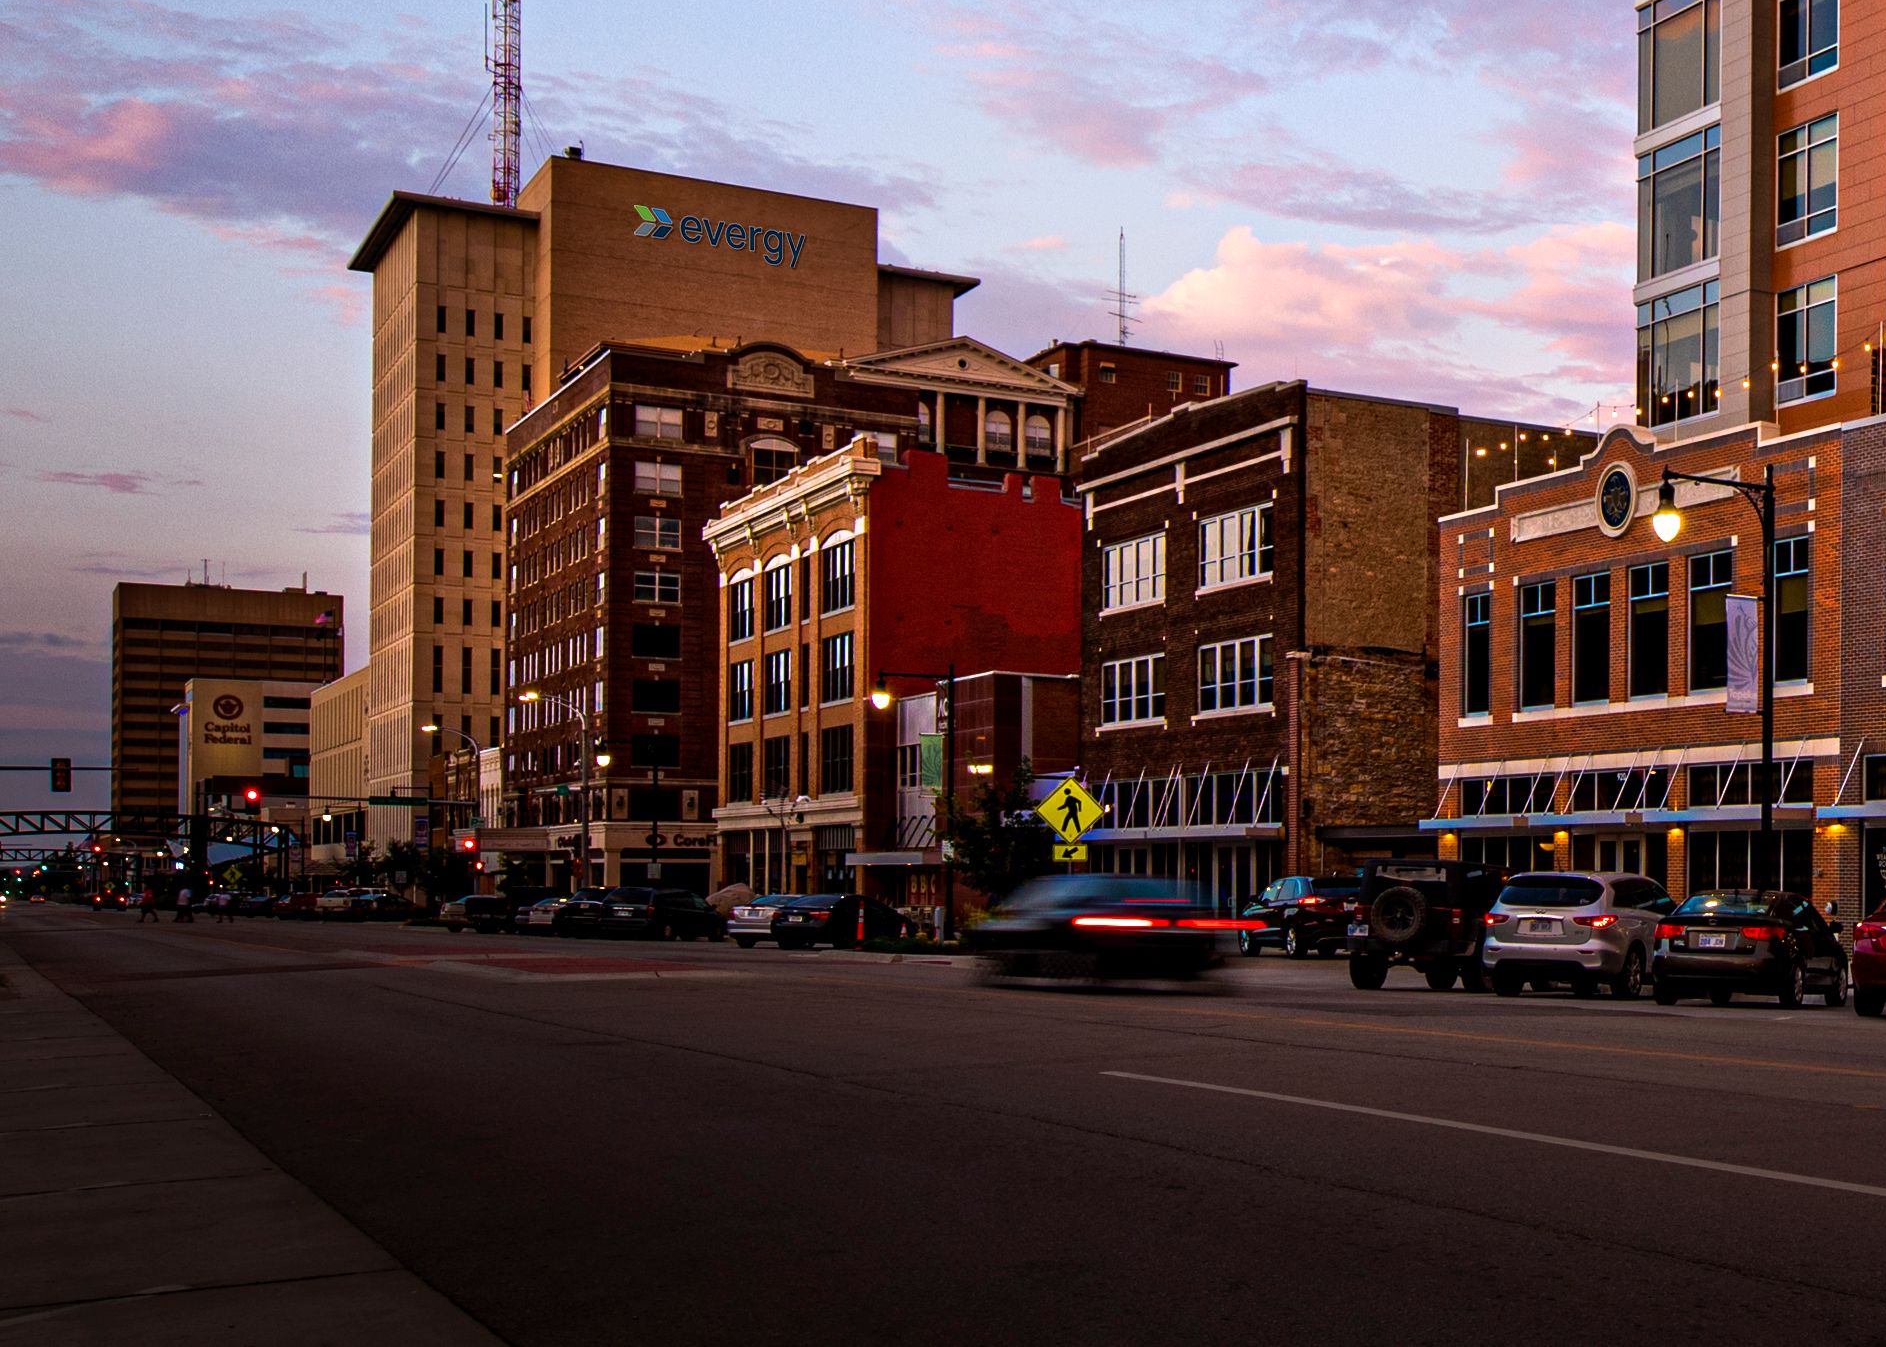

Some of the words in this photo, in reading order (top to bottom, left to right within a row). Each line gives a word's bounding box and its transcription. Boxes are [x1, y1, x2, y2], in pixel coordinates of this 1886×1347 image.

[680, 215, 806, 269] evergy
[204, 721, 251, 734] Capitol
[204, 733, 252, 745] Federal
